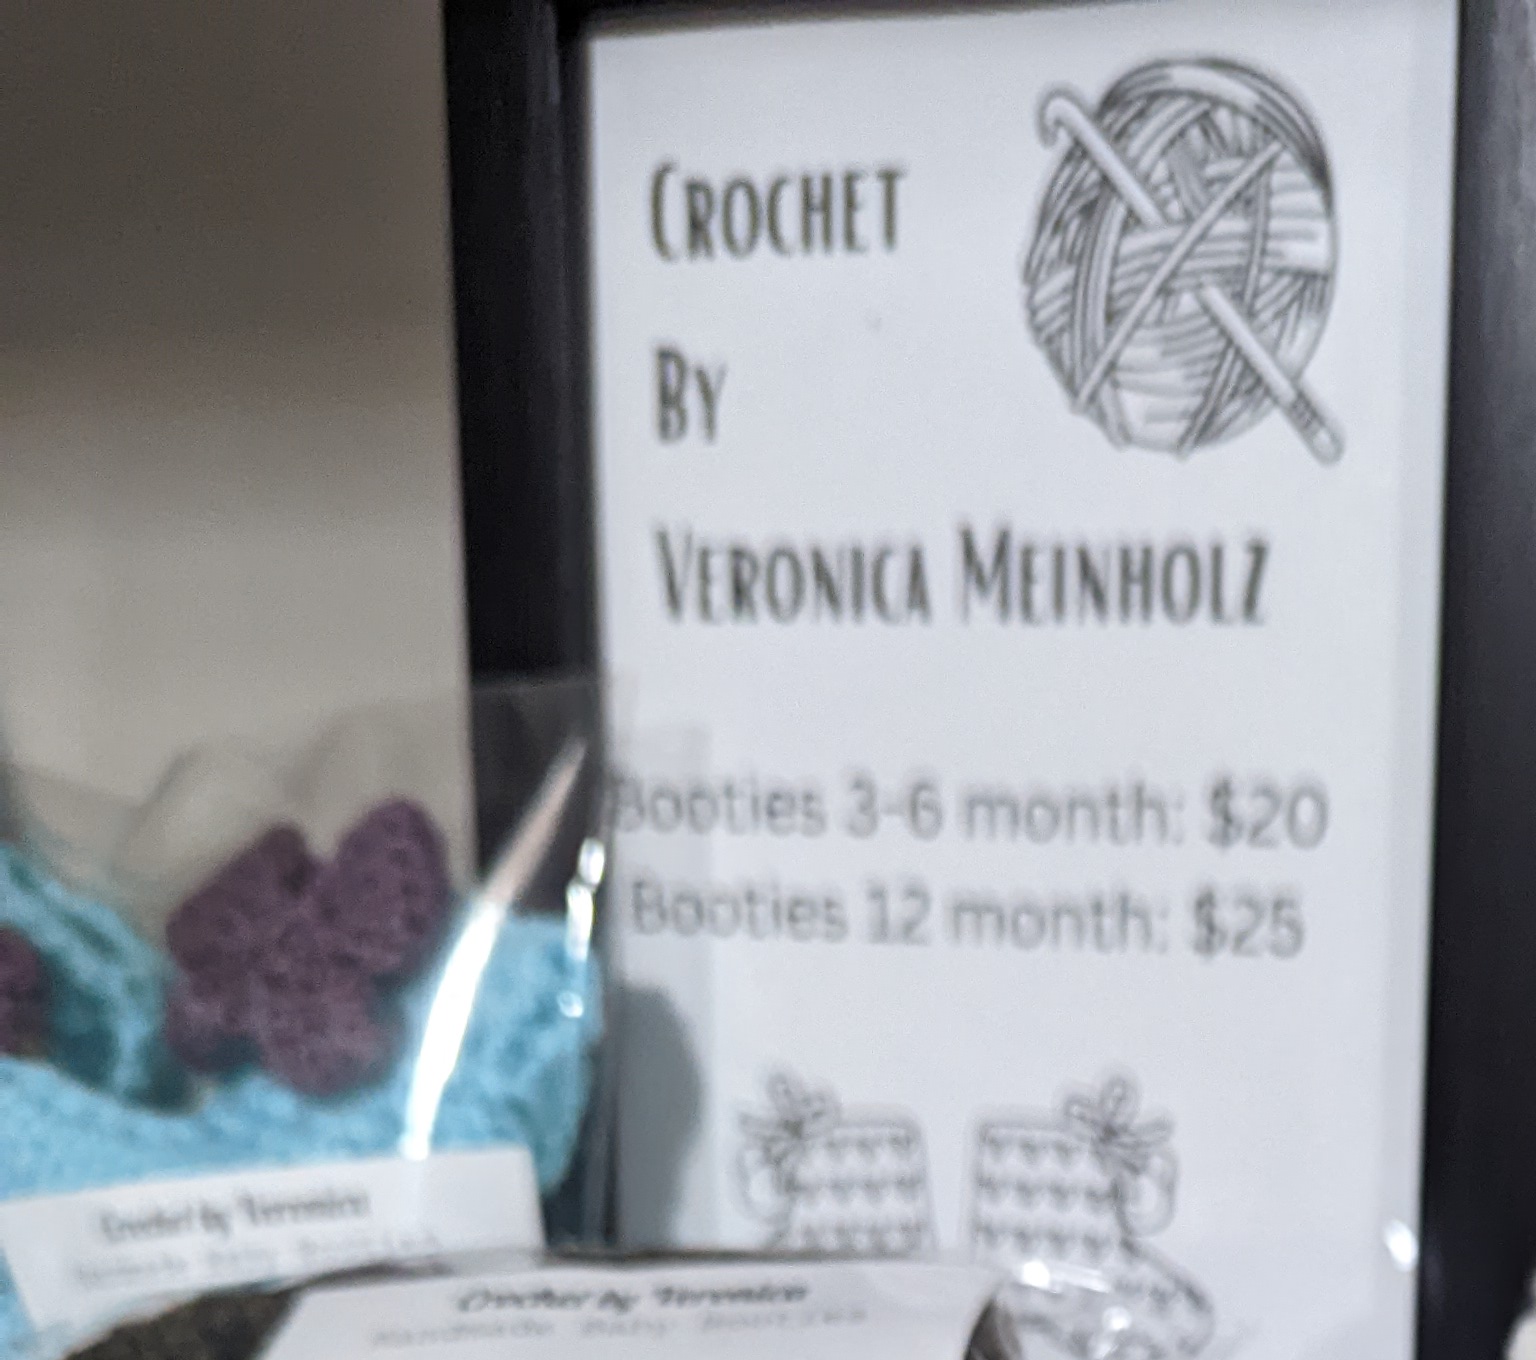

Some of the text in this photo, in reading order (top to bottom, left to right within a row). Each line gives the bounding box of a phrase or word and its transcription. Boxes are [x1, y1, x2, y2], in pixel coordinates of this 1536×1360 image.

[612, 771, 1328, 851] Booties 3-6 month: $20
[632, 879, 1303, 960] Booties 12 month: $25
